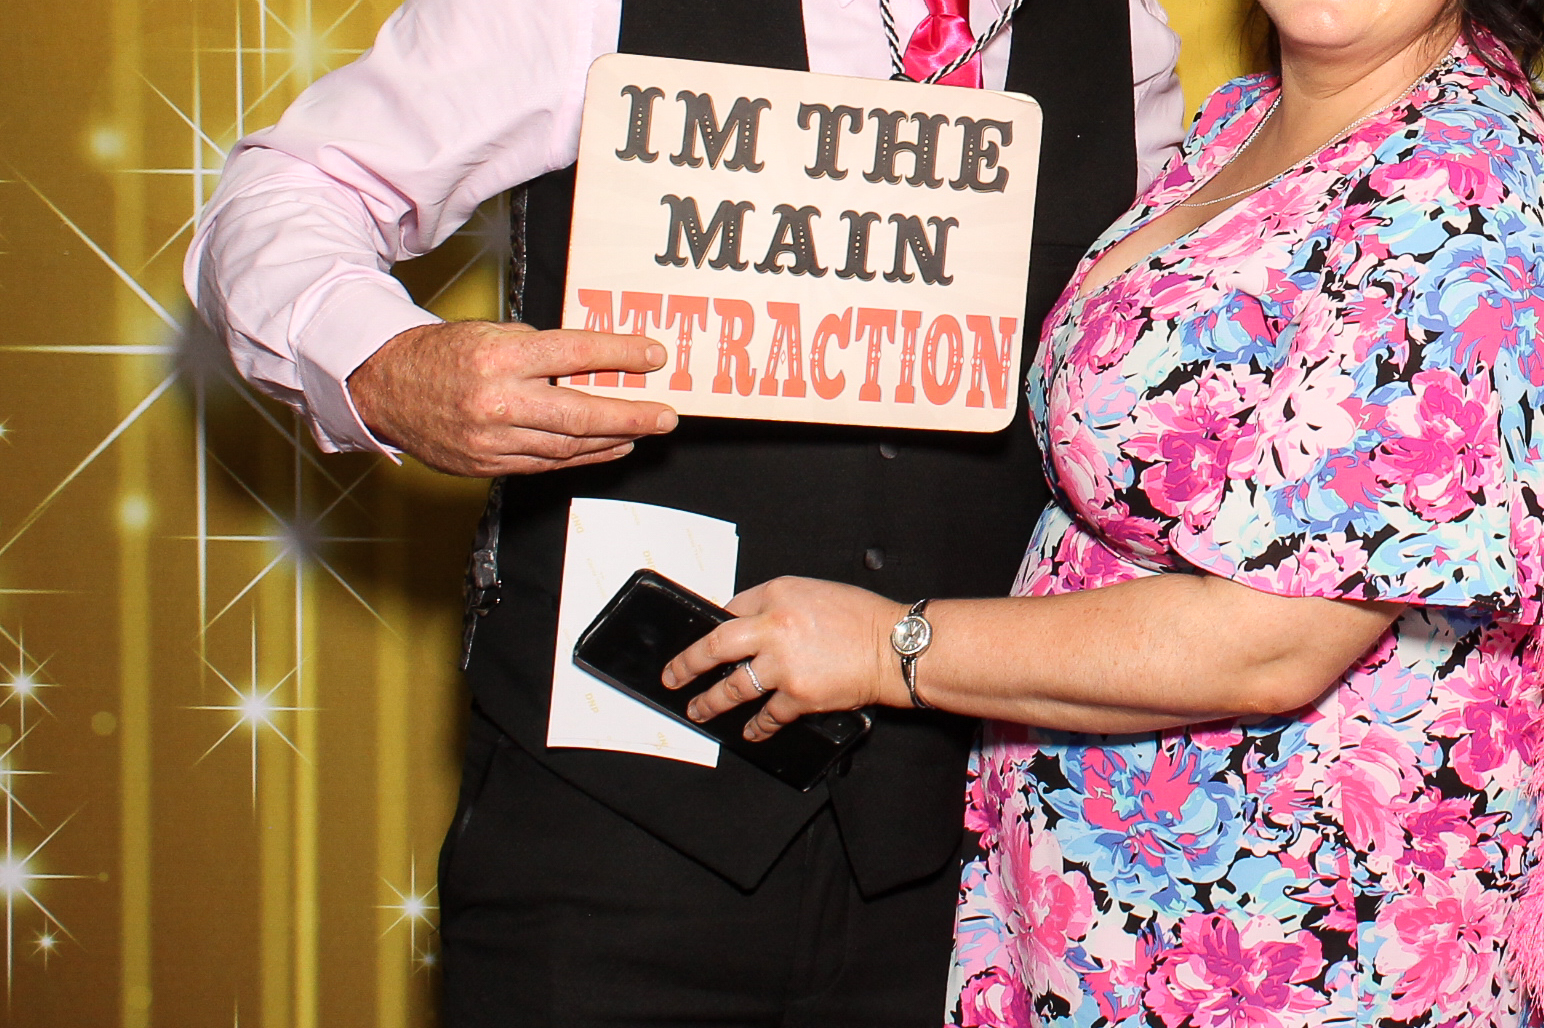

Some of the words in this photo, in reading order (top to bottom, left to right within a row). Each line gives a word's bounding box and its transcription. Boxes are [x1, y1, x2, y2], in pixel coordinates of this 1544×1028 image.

[615, 84, 772, 174] IM
[797, 102, 1014, 194] THE
[654, 193, 960, 287] MAIN
[569, 288, 1019, 410] ATTRACTION
[585, 692, 600, 714] DNP
